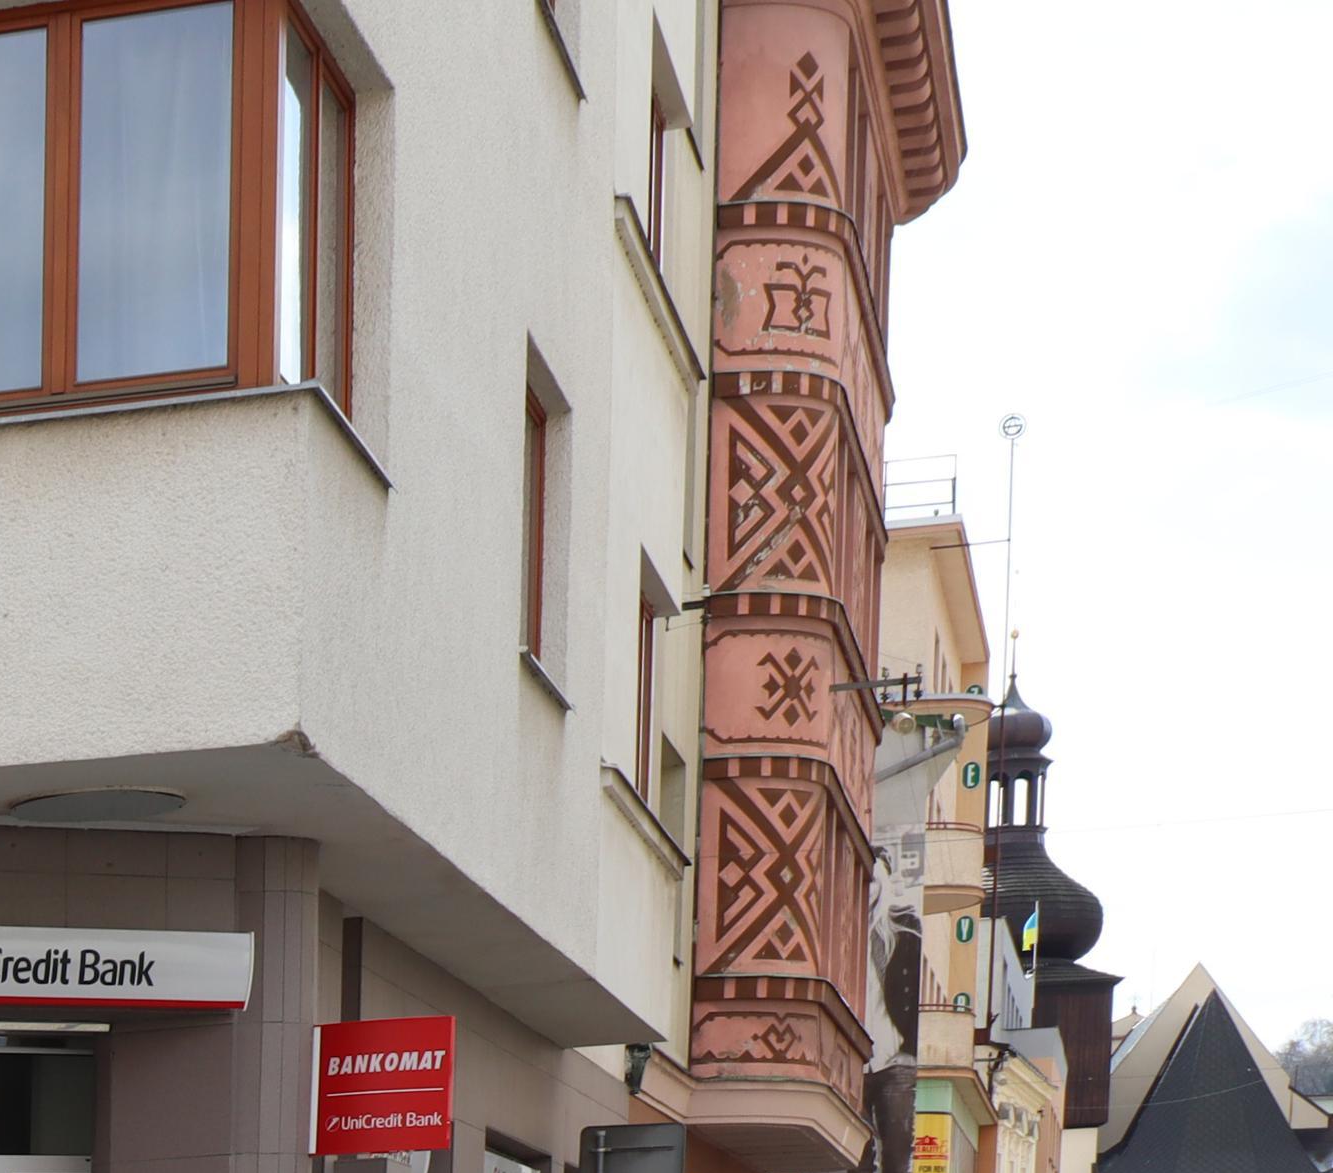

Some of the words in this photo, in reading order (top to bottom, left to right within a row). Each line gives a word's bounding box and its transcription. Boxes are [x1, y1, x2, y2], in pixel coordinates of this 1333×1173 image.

[78, 949, 155, 986] Bank
[327, 1050, 446, 1076] BANKOMAT
[341, 1112, 402, 1130] UniCredit
[406, 1111, 442, 1127] Bank
